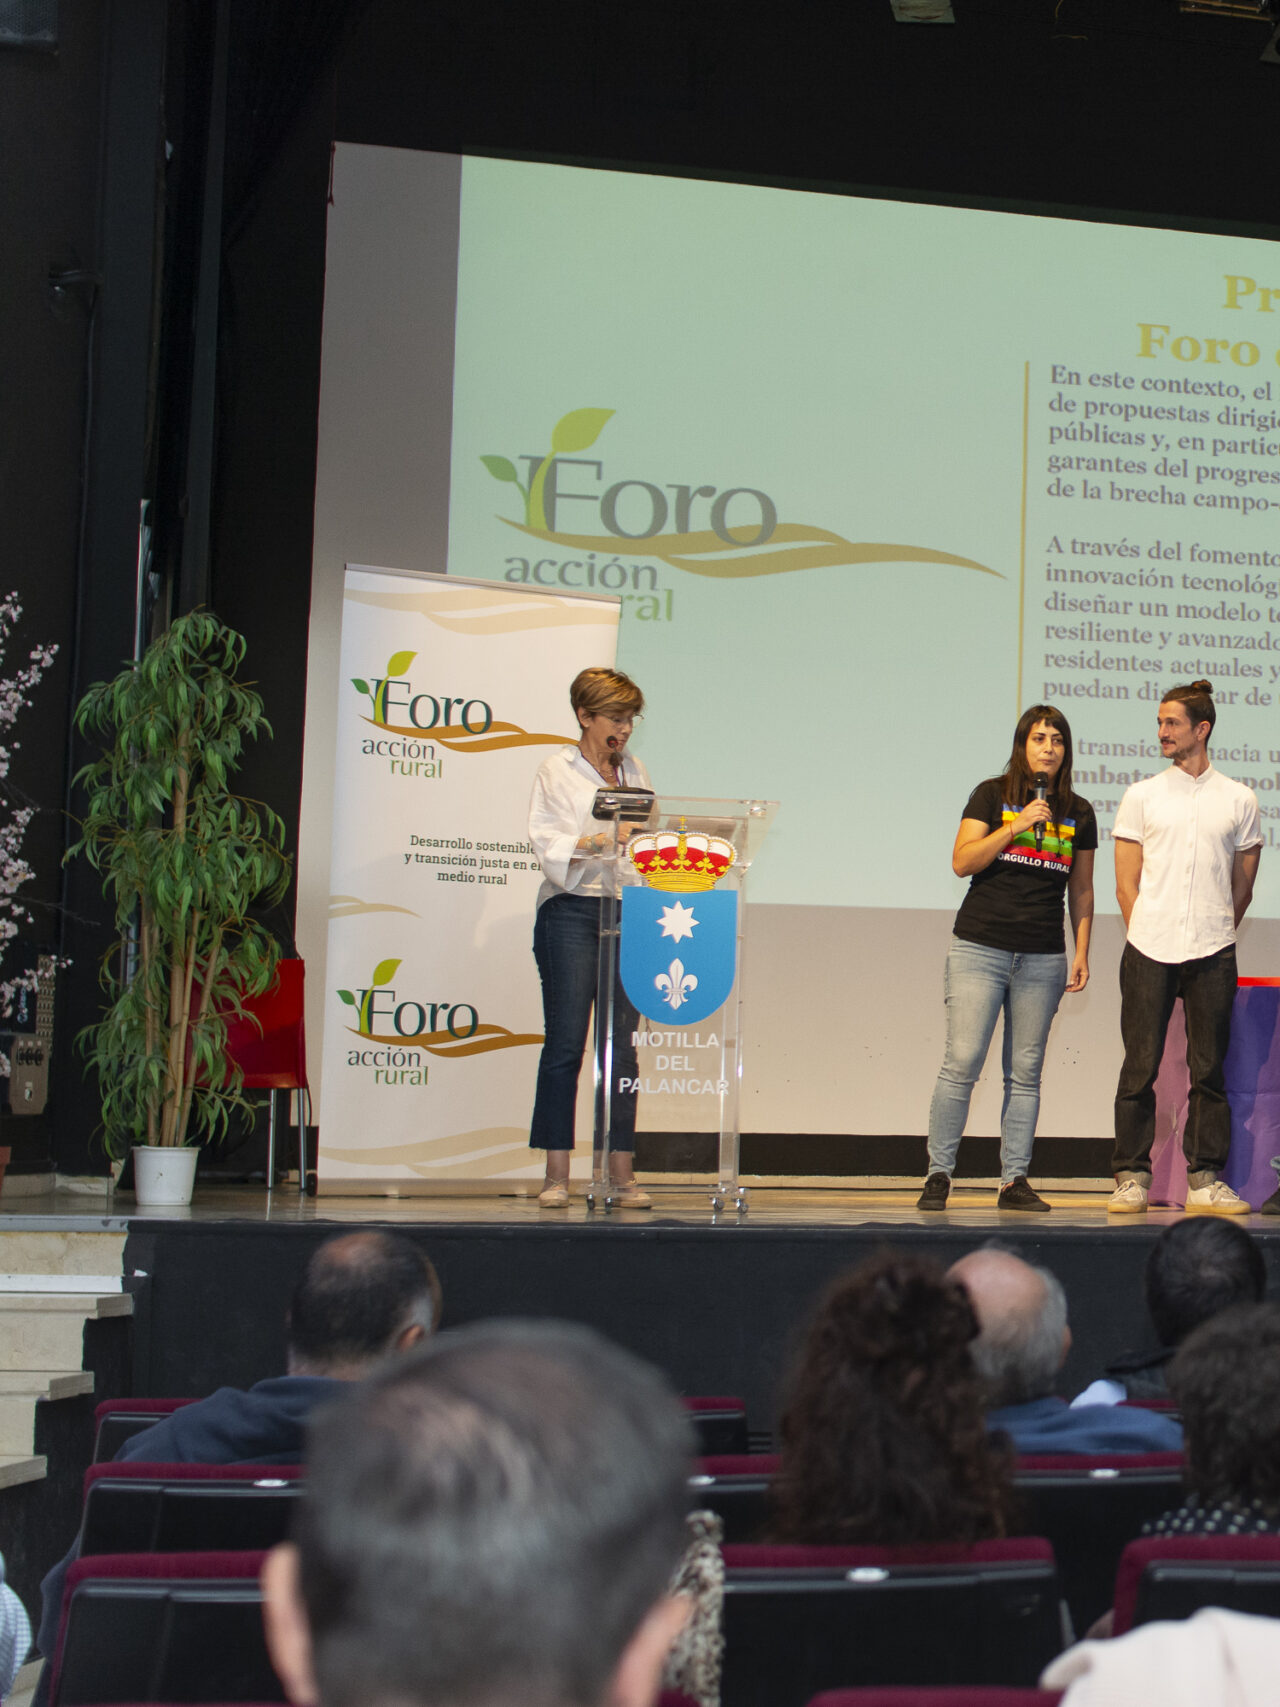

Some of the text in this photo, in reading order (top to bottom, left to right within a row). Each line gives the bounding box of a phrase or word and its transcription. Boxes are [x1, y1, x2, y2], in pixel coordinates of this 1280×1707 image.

[1136, 323, 1261, 367] Foro
[1051, 364, 1082, 386] En
[1087, 371, 1136, 390] este
[1140, 378, 1246, 401] contexto,
[1252, 381, 1273, 401] el
[1048, 391, 1077, 413] de
[1084, 400, 1211, 423] propuestas
[1048, 421, 1146, 446] públicas
[1150, 434, 1171, 453] y,
[1177, 437, 1206, 451] en
[1046, 455, 1148, 475] garantes
[1153, 457, 1189, 478] del
[518, 454, 777, 547] Foro
[1046, 477, 1076, 498] de
[1082, 479, 1102, 500] la
[1109, 481, 1187, 506] brecha
[1045, 536, 1065, 554] A
[1070, 537, 1141, 558] través
[1147, 539, 1182, 561] del
[504, 553, 659, 591] acción
[1045, 562, 1175, 589] innovación
[1044, 590, 1134, 615] diseñar
[1139, 602, 1169, 618] un
[1175, 601, 1262, 622] modelo
[1045, 621, 1153, 644] resiliente
[1157, 631, 1173, 650] y
[1044, 650, 1163, 673] residentes
[1170, 657, 1263, 678] actuales
[370, 678, 493, 734] Foro
[1043, 679, 1130, 700] puedan
[1244, 686, 1271, 706] de
[362, 738, 435, 760] acción
[390, 758, 443, 778] rural
[410, 835, 473, 850] Desarrollo
[404, 853, 411, 865] y
[415, 853, 477, 867] transición
[479, 856, 510, 869] justa
[513, 861, 527, 869] en
[998, 852, 1070, 873] ORGULLO RURAL
[437, 870, 507, 885] medio rural
[355, 988, 478, 1038] Foro
[631, 1030, 720, 1048] MOTILLA
[347, 1046, 421, 1067] acción
[655, 1054, 695, 1072] DEL
[374, 1065, 428, 1086] rural
[618, 1076, 729, 1095] PALANCAR
